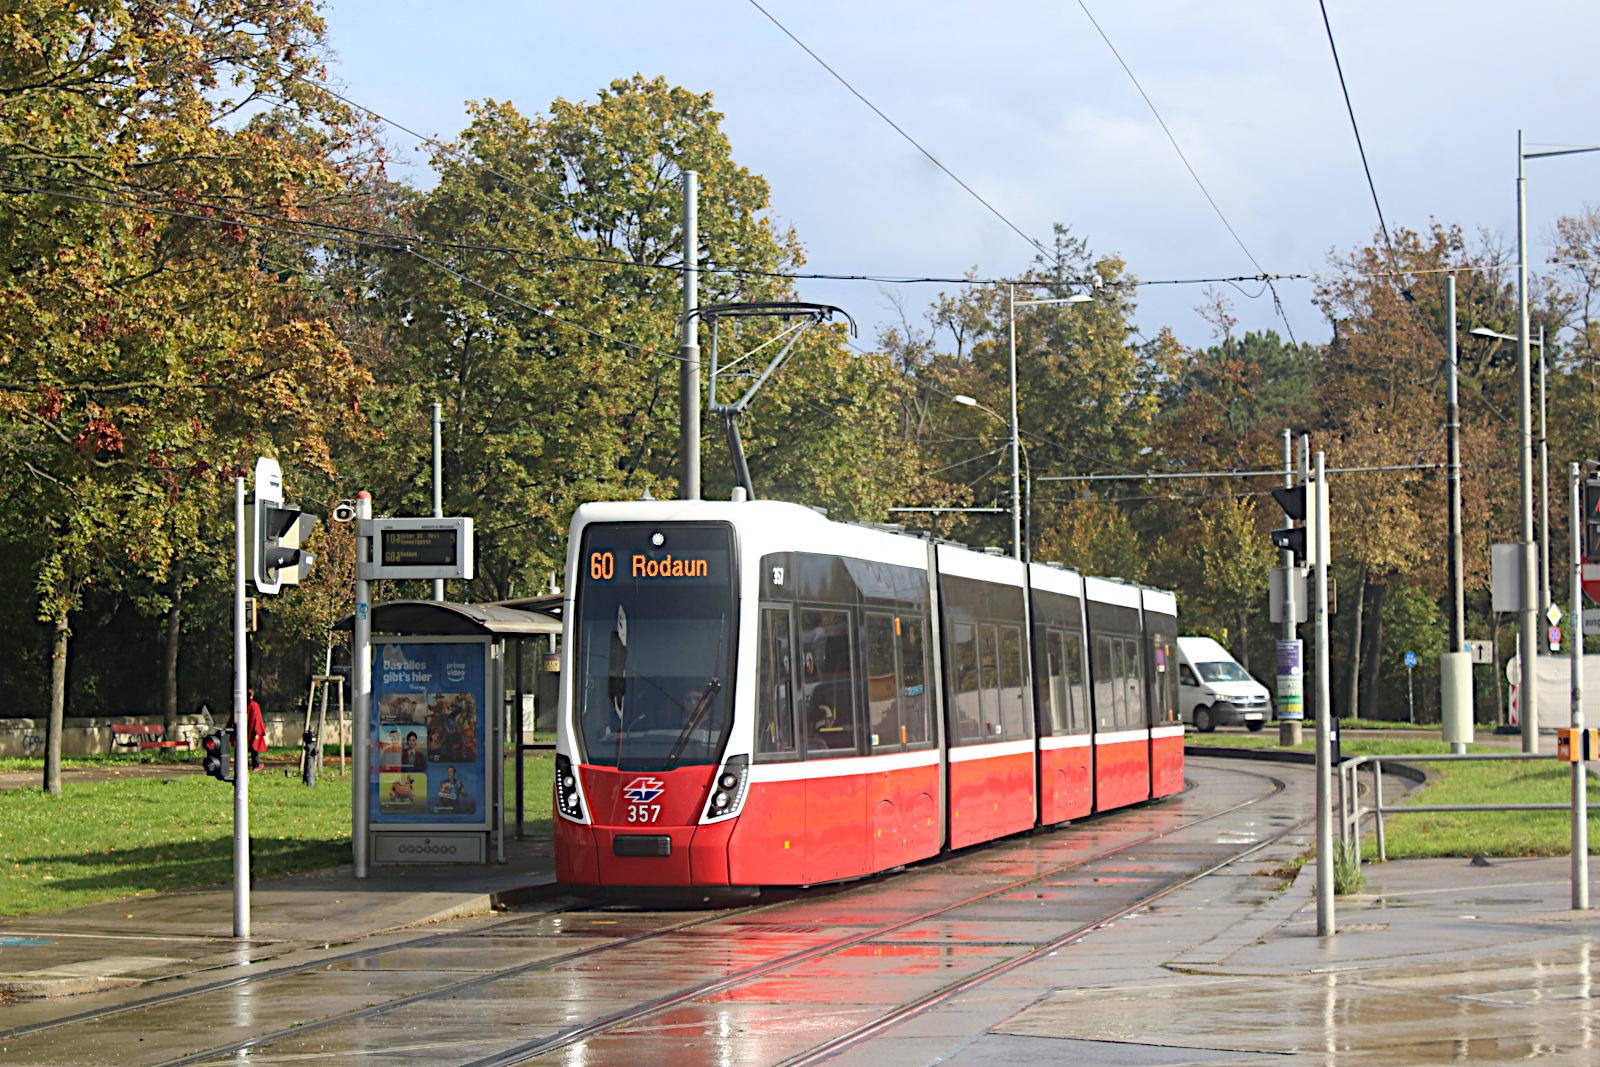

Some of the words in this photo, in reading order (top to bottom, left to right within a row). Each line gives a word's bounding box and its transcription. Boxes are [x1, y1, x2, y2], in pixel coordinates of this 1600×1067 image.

[590, 551, 614, 580] 60
[632, 554, 708, 577] Rodaun
[772, 566, 784, 585] 357
[383, 660, 402, 670] Das
[403, 660, 426, 670] alles
[412, 672, 432, 682] hier
[627, 804, 661, 823] 357
